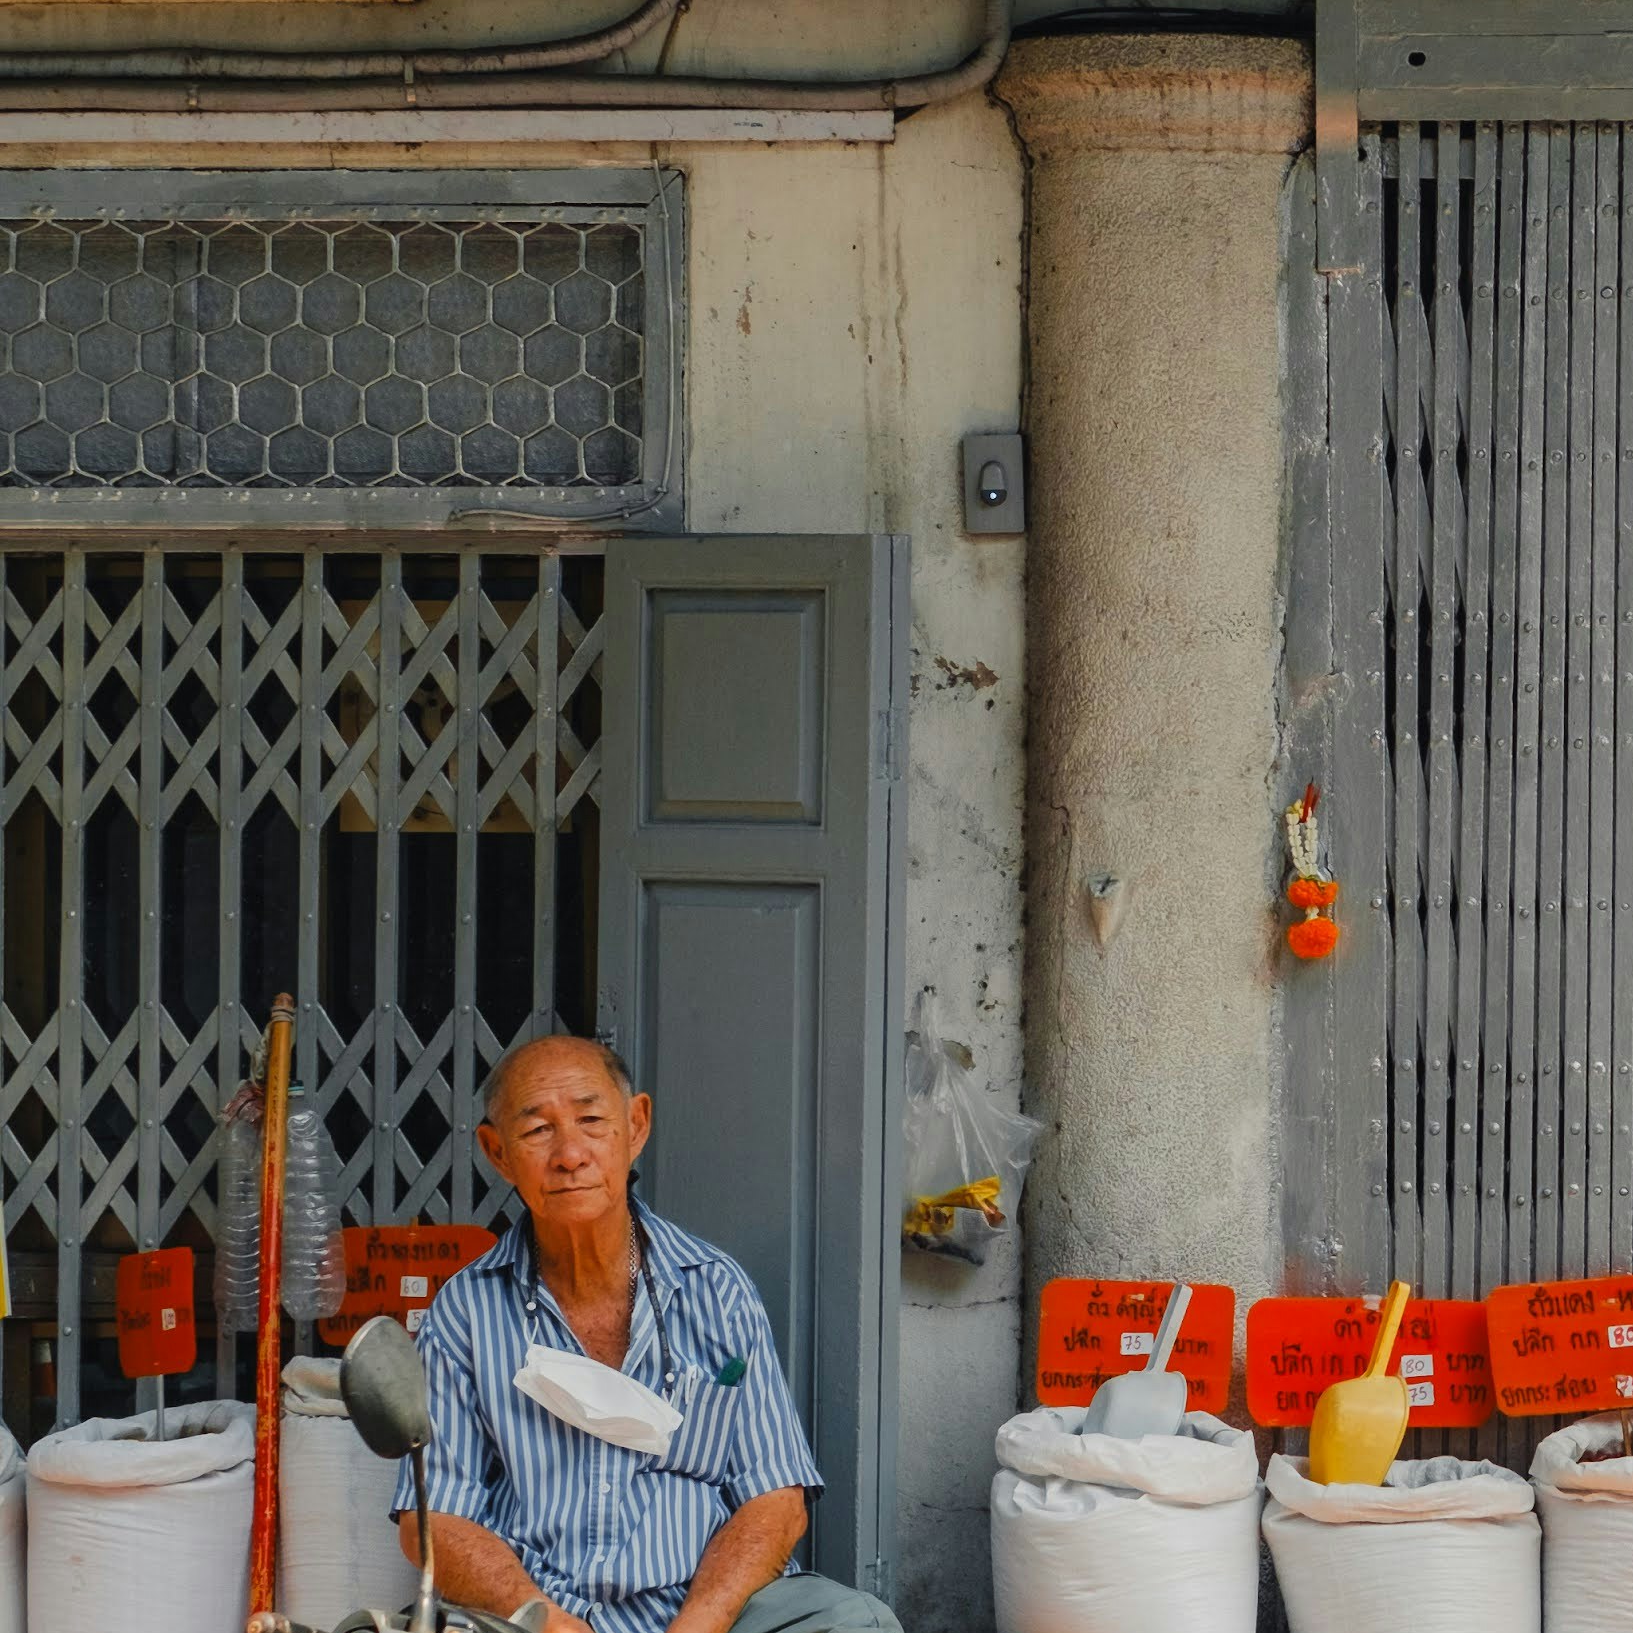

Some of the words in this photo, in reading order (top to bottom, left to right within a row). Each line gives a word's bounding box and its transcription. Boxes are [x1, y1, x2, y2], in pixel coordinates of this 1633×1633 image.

[1123, 1335, 1141, 1350] 75
[1405, 1359, 1424, 1374] 80
[1447, 1352, 1485, 1371] บาท
[1409, 1388, 1427, 1403] 75
[1450, 1384, 1487, 1403] บาท
